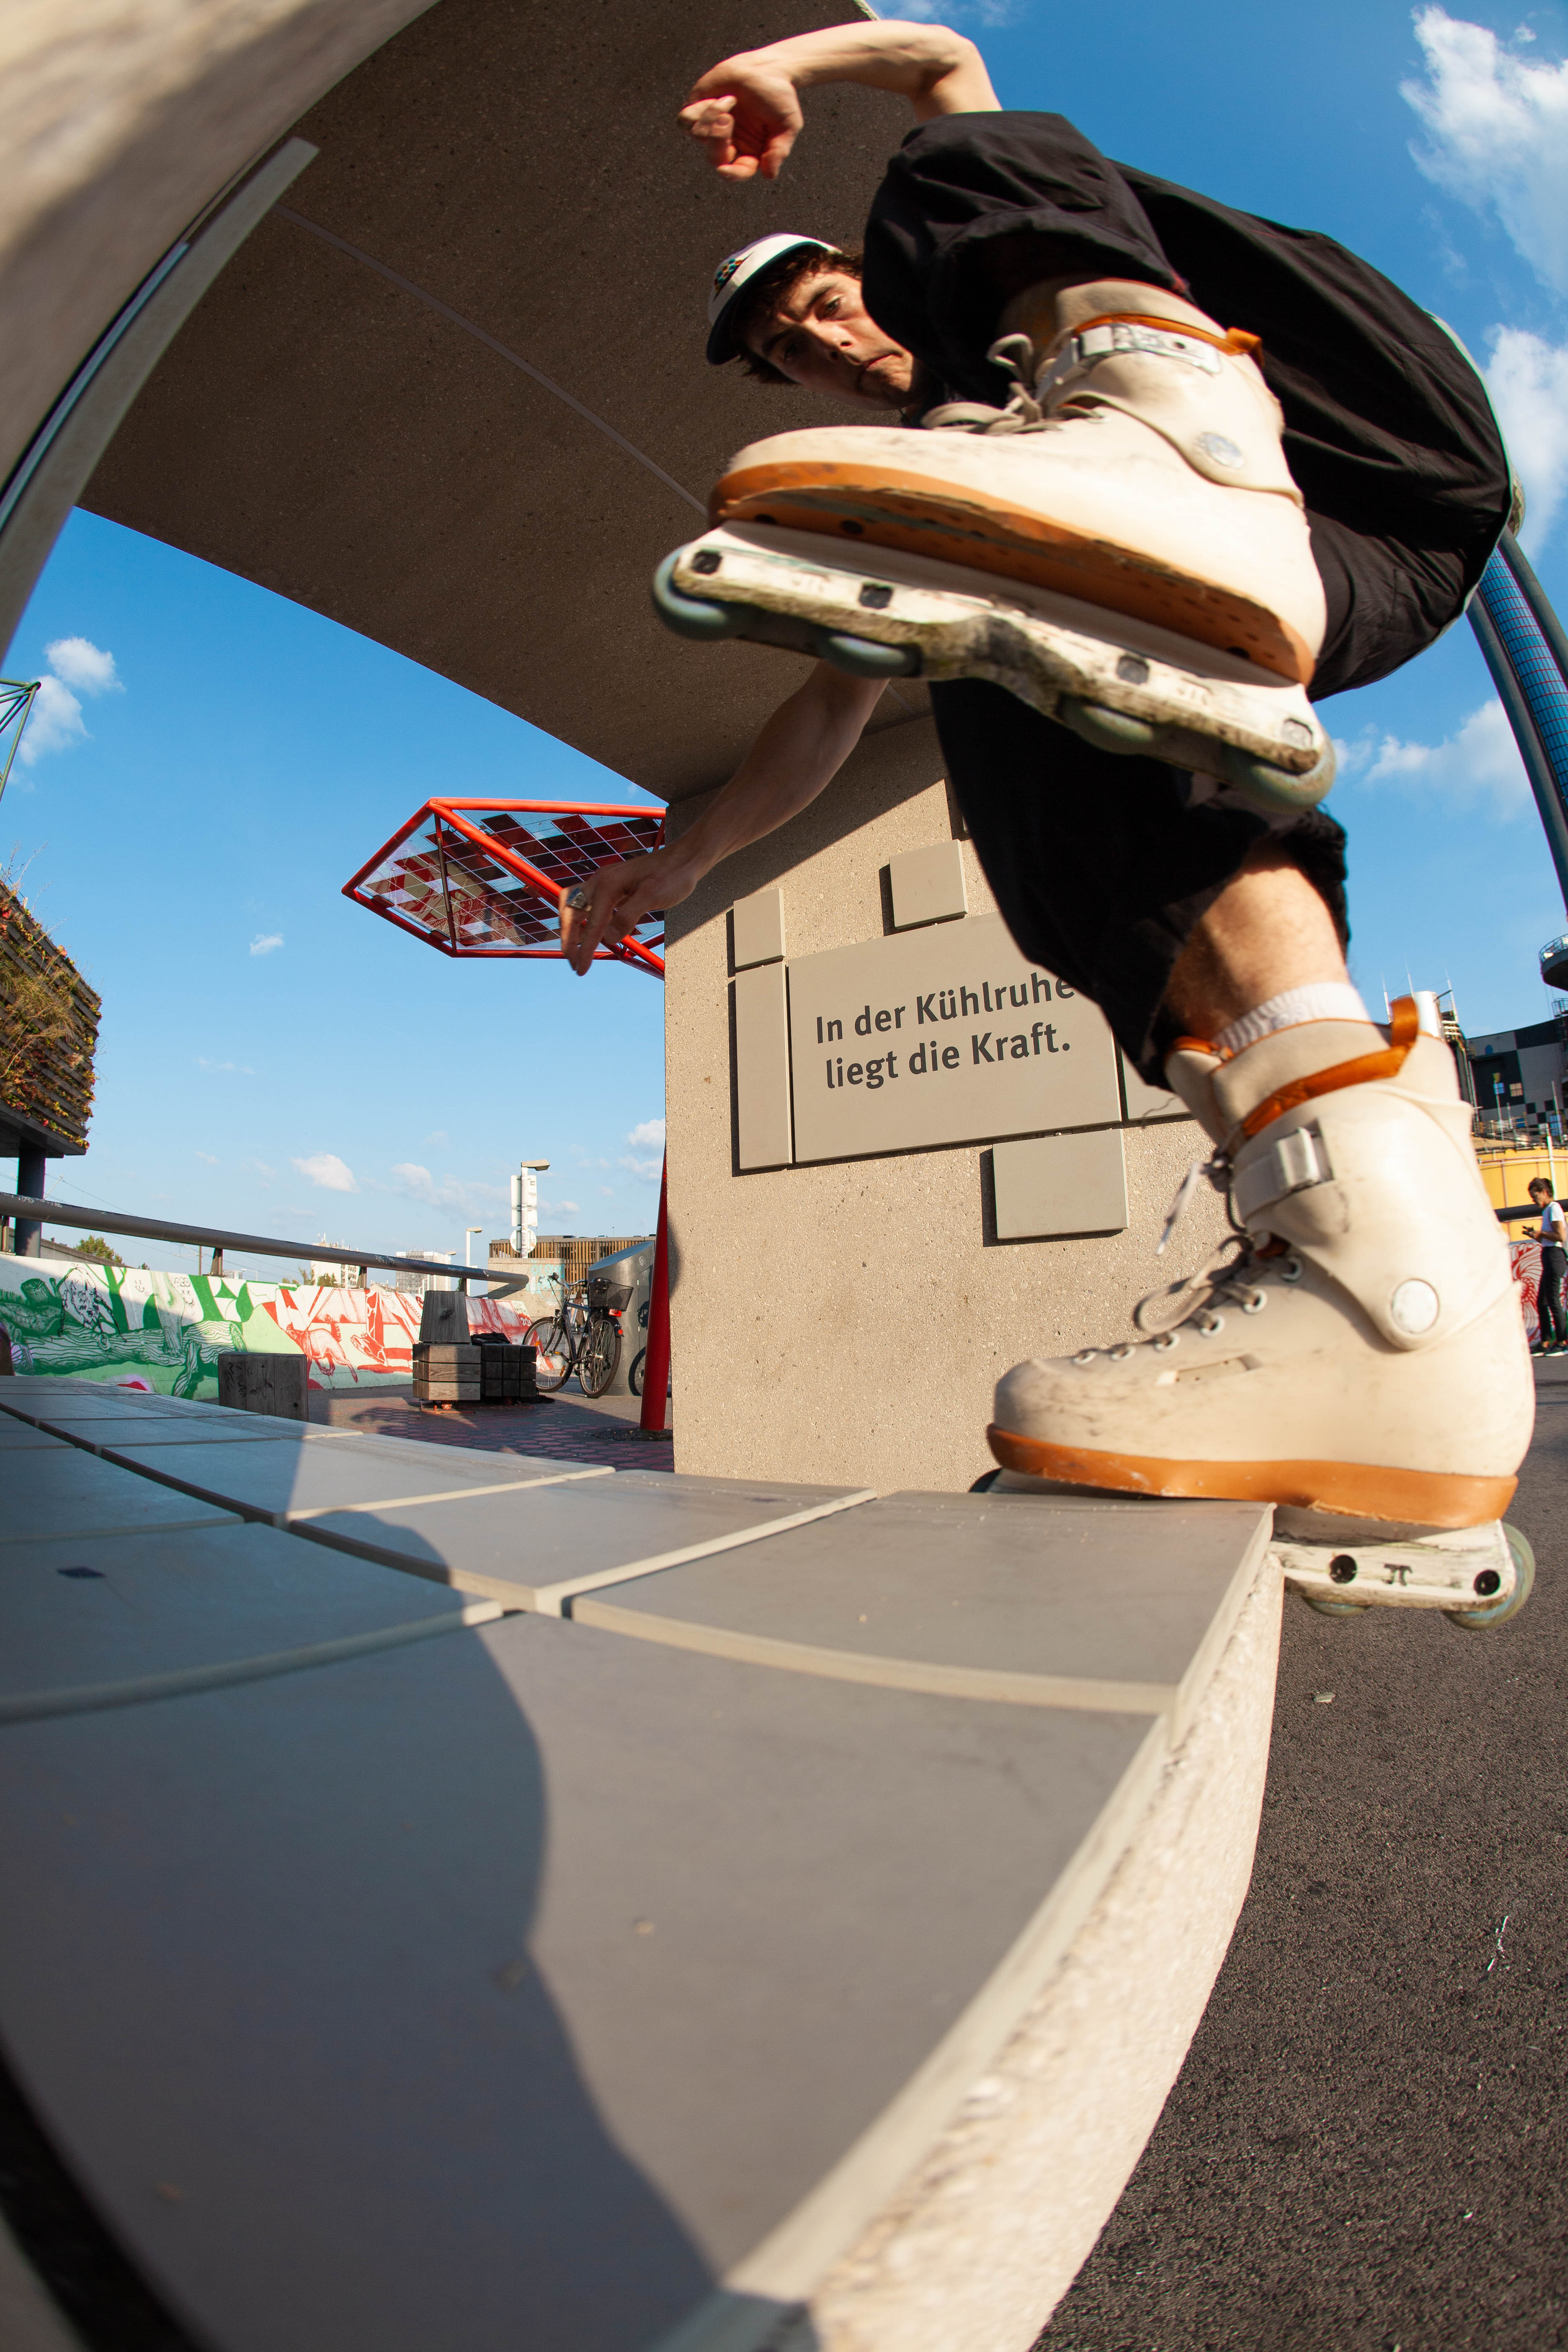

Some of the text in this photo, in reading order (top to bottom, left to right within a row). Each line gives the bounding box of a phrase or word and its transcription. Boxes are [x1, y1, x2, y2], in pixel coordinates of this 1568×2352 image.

[816, 972, 1075, 1044] In der Kühlruhe
[825, 1021, 1070, 1090] liegt die Kraft.
